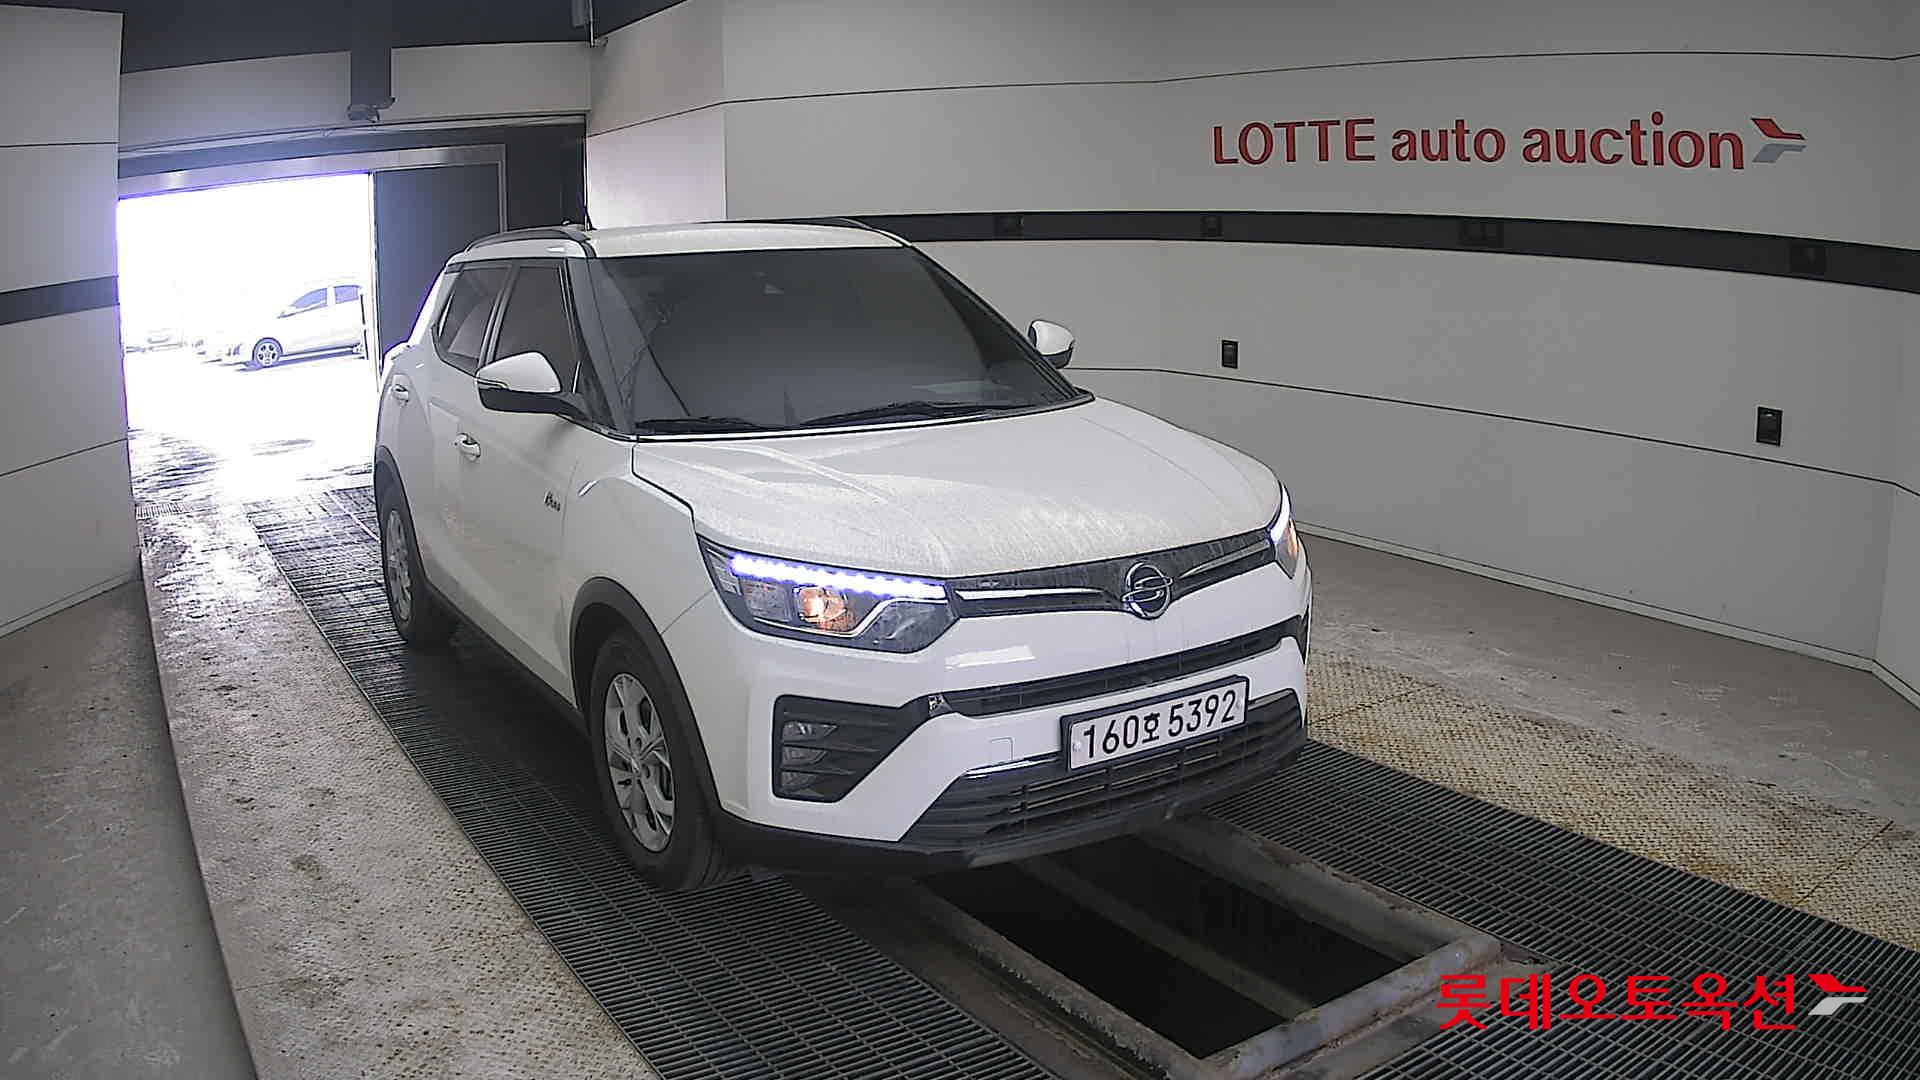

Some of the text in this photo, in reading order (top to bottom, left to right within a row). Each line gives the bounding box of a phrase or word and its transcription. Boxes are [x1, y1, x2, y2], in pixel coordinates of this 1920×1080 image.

[1212, 111, 1745, 170] LOTTE auto auction
[1083, 690, 1236, 758] 160호 5392
